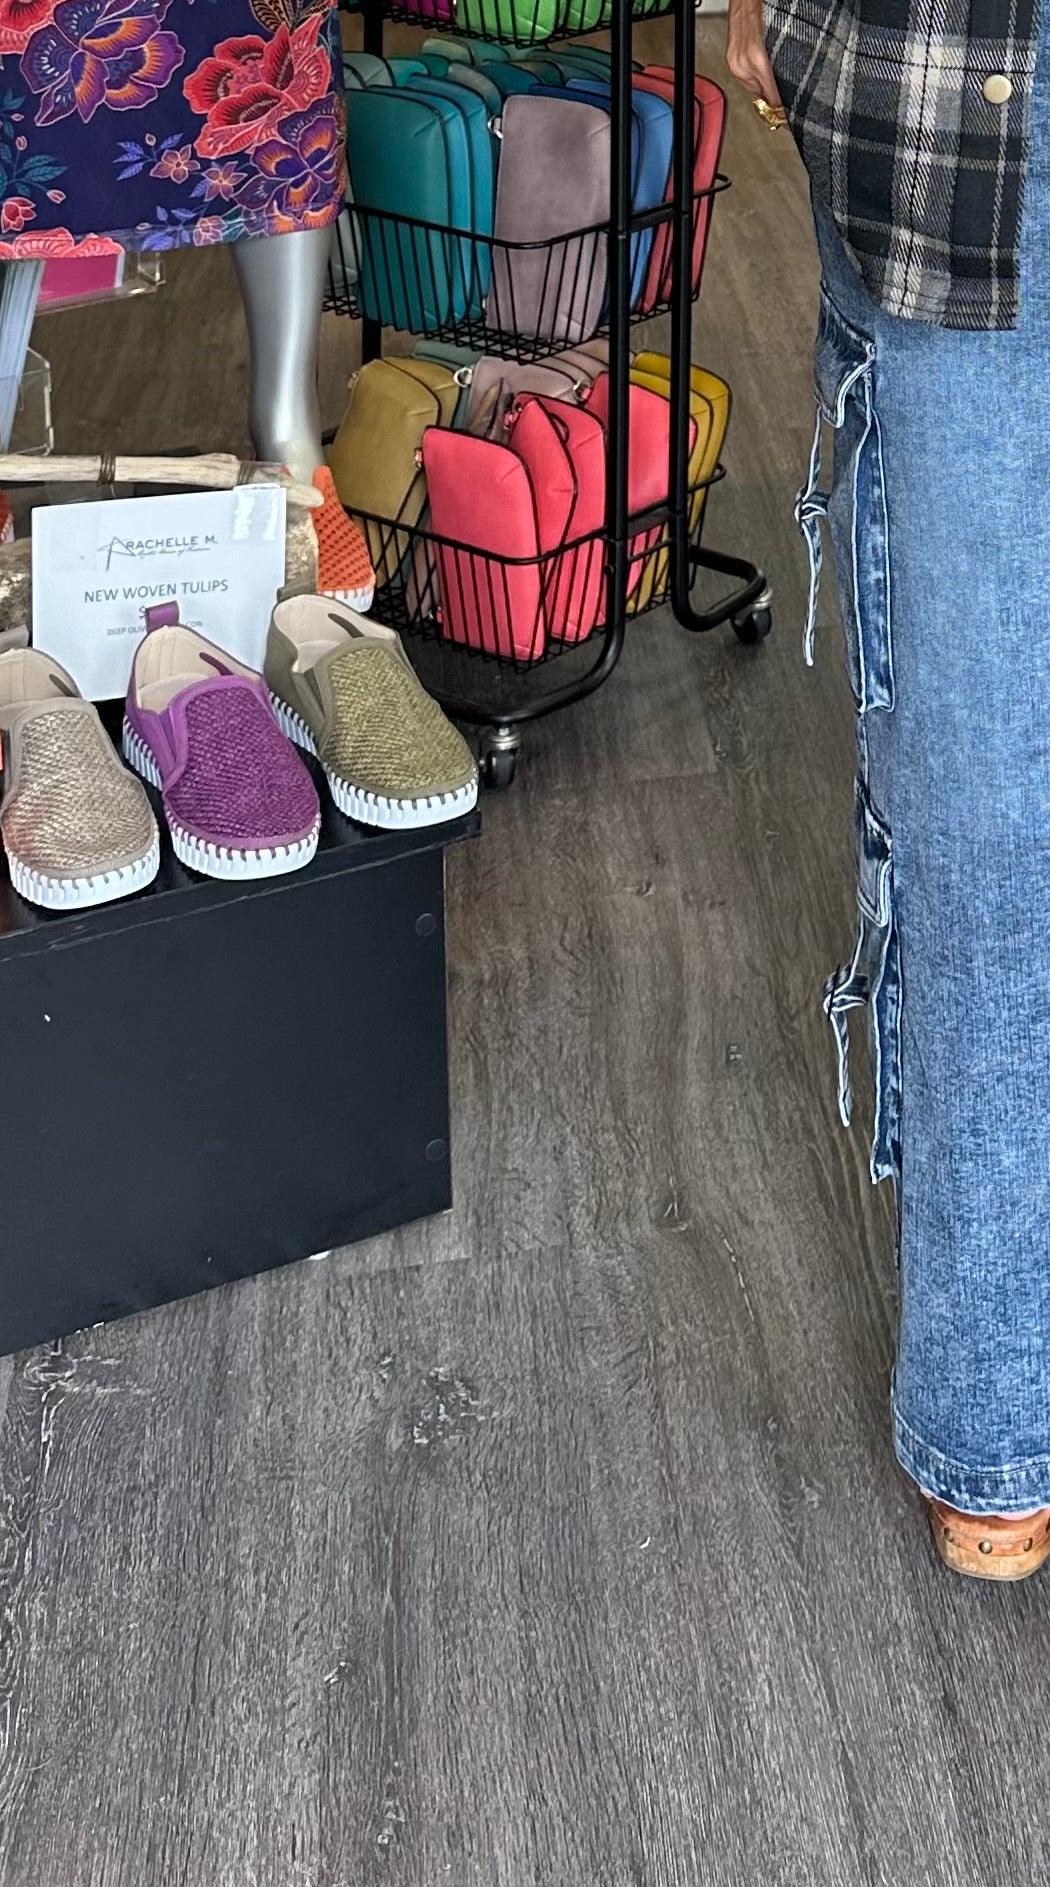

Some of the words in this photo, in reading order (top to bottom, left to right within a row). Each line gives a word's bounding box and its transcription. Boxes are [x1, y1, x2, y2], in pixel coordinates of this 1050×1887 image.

[84, 588, 119, 603] NEW
[122, 583, 177, 599] WOVEN
[181, 579, 229, 594] TULIPS
